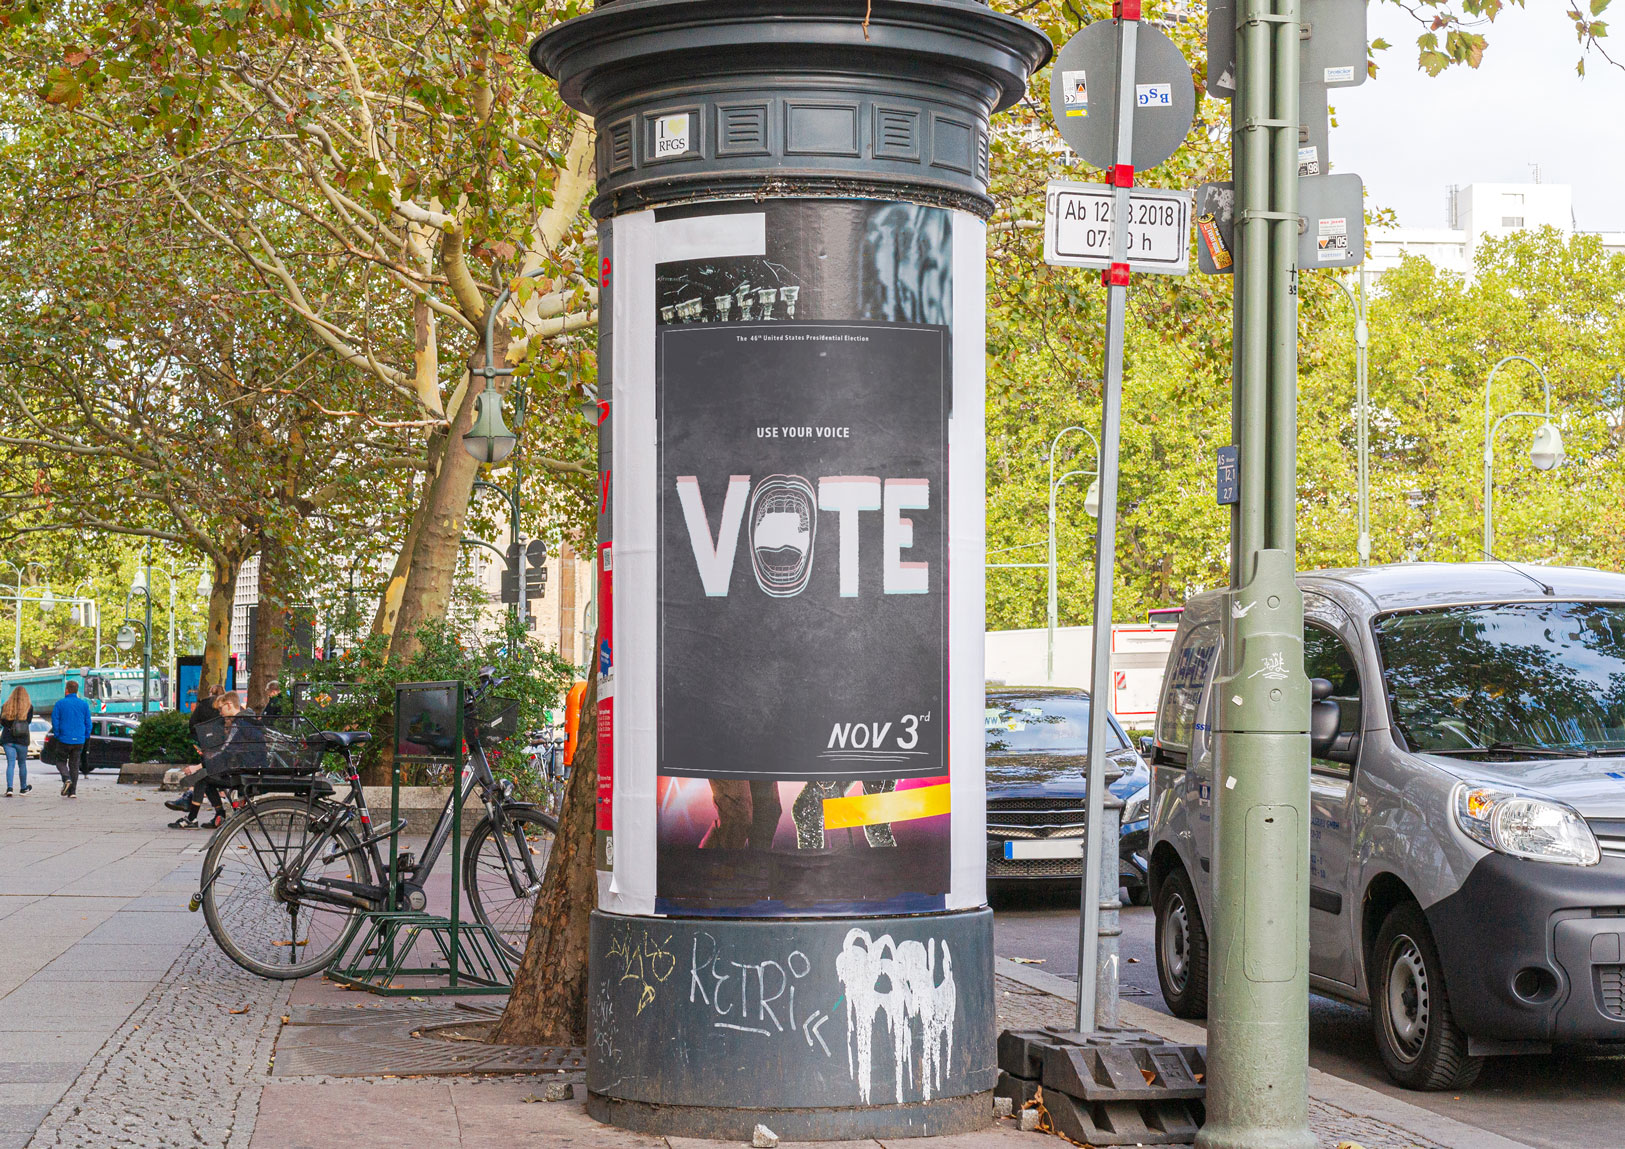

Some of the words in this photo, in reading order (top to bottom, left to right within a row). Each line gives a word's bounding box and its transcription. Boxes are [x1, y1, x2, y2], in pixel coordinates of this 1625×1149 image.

[659, 120, 665, 138] I
[659, 138, 686, 151] RFGS
[1065, 200, 1086, 221] Ab
[1142, 232, 1152, 251] h
[756, 427, 779, 438] USE
[782, 426, 813, 438] YOUR
[815, 427, 850, 438] VOICE
[676, 474, 930, 598] VOTE
[827, 722, 893, 749] NOV
[896, 711, 931, 750] 3rd
